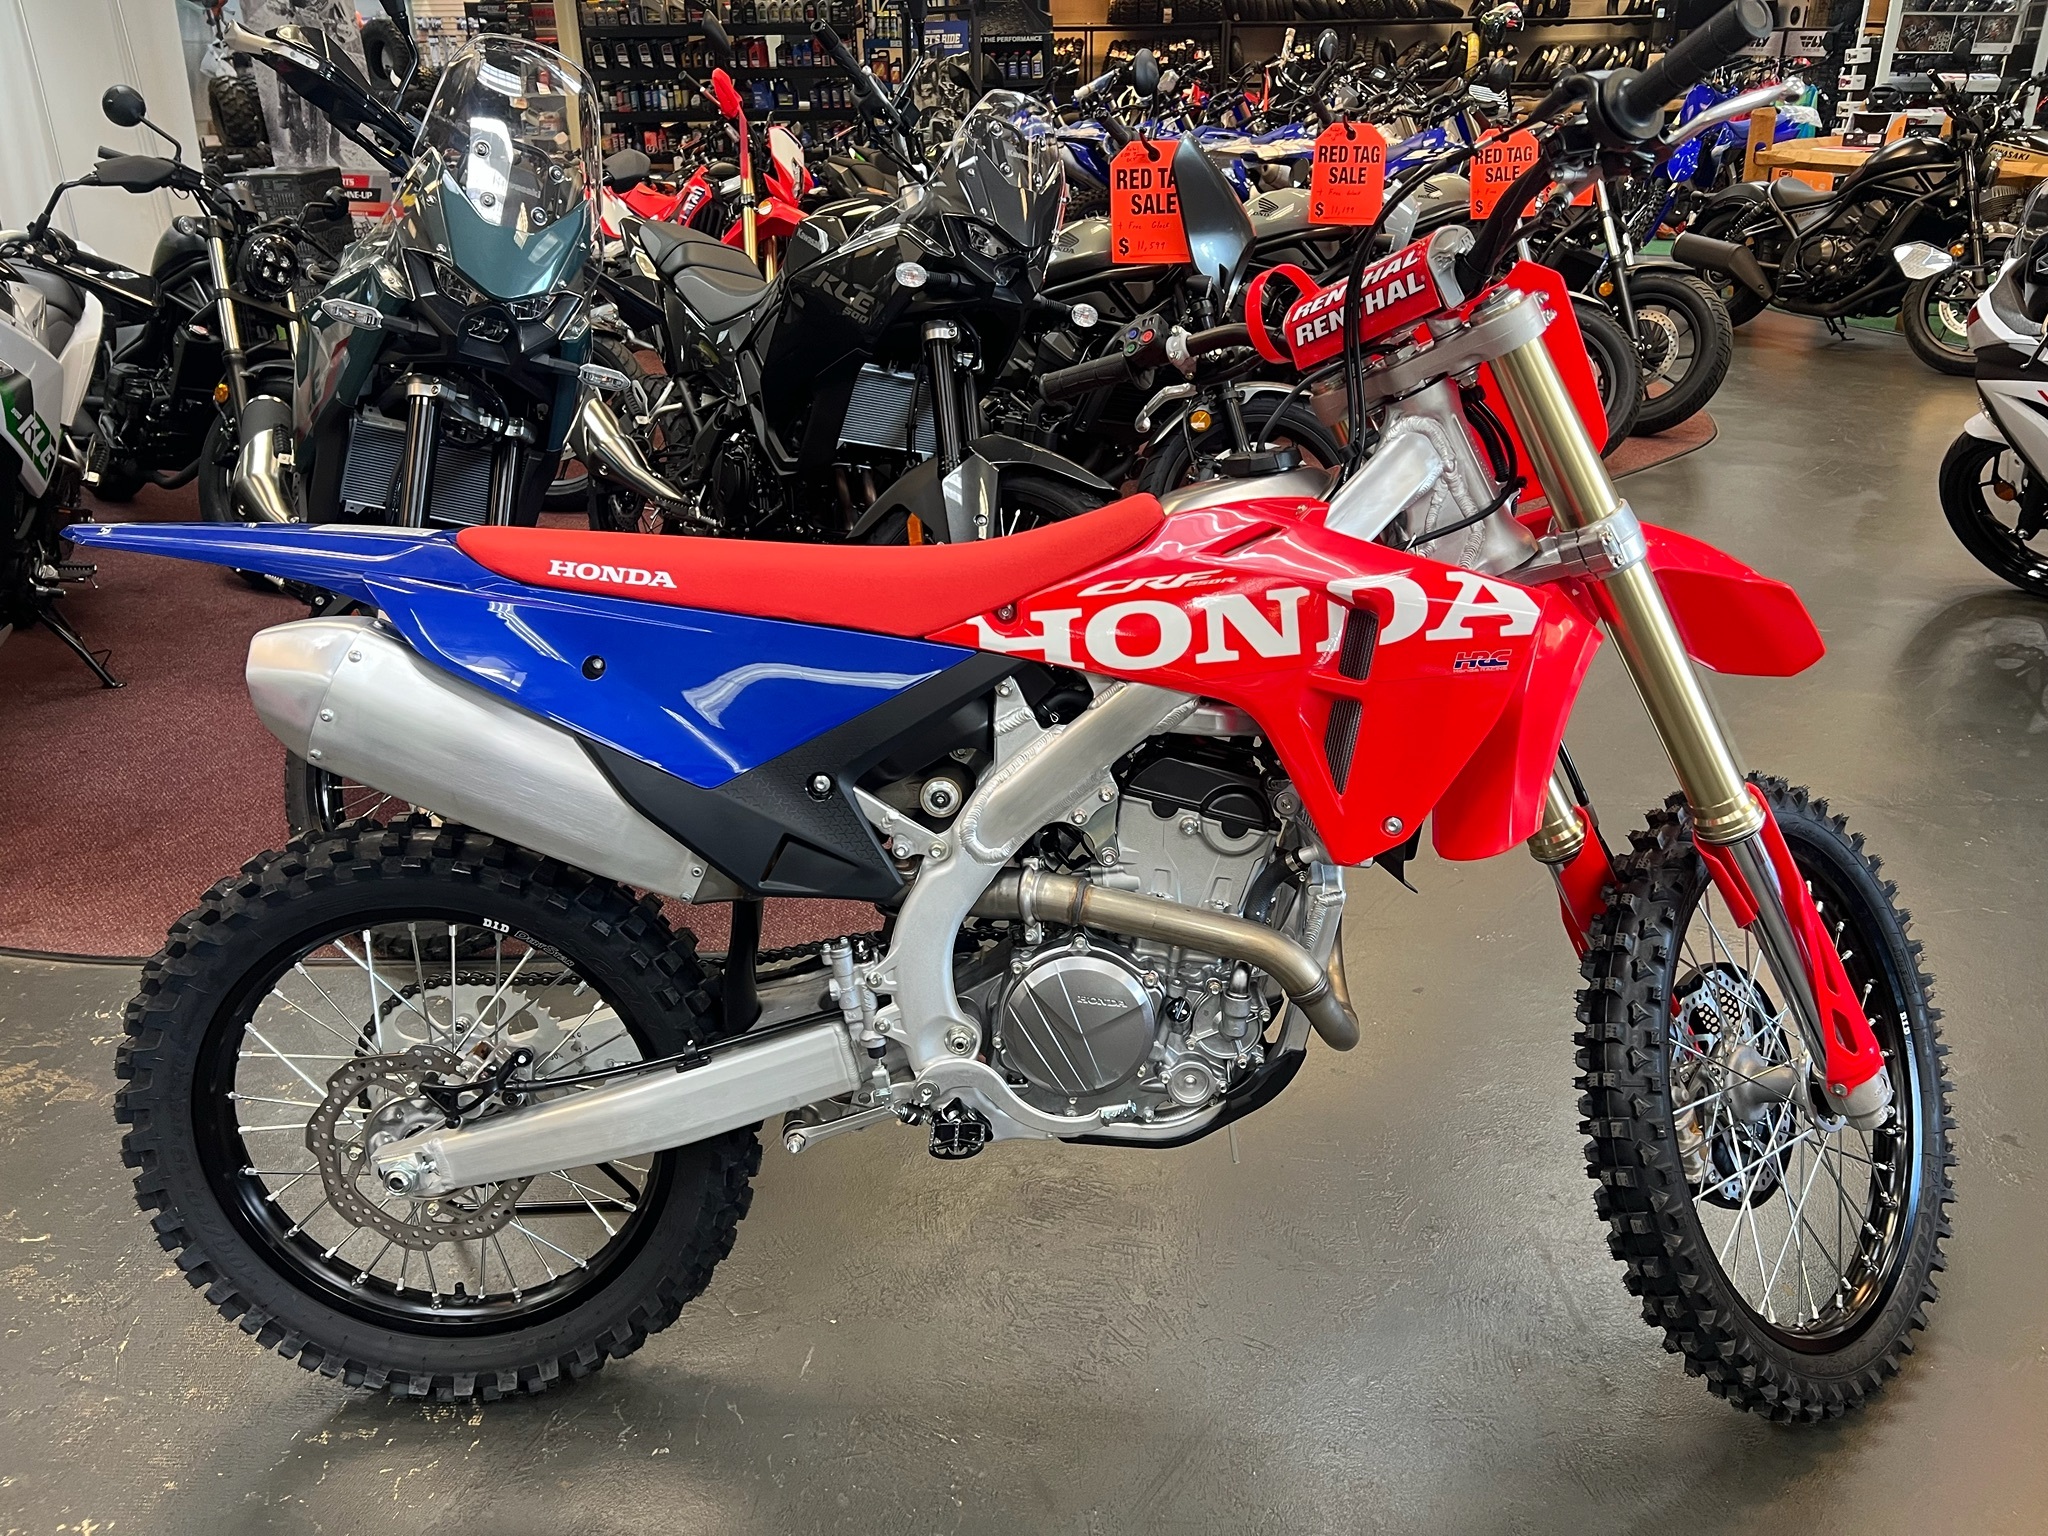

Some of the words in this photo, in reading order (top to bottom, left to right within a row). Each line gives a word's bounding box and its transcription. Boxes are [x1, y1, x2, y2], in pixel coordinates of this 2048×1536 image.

[942, 33, 961, 44] RIDE
[1318, 145, 1348, 163] RED
[1353, 145, 1380, 163] TAG
[1475, 148, 1502, 165] RED
[1507, 146, 1533, 162] TAG
[1116, 168, 1152, 190] RED
[1158, 167, 1177, 189] TA
[1328, 166, 1367, 185] SALE
[1485, 165, 1520, 183] SALE
[1131, 193, 1177, 216] SALE
[1314, 201, 1325, 218] $
[1475, 200, 1484, 214] $
[1118, 237, 1129, 256] $
[813, 270, 876, 314] KLE
[1291, 250, 1419, 323] RENHAL
[1295, 272, 1426, 347] RENHAL
[547, 559, 678, 589] HONDA
[1076, 569, 1224, 598] CRF
[964, 571, 1541, 671] HONDA
[1453, 649, 1513, 670] HRC
[482, 917, 510, 933] D.I.D
[1076, 994, 1129, 1009] HONDA
